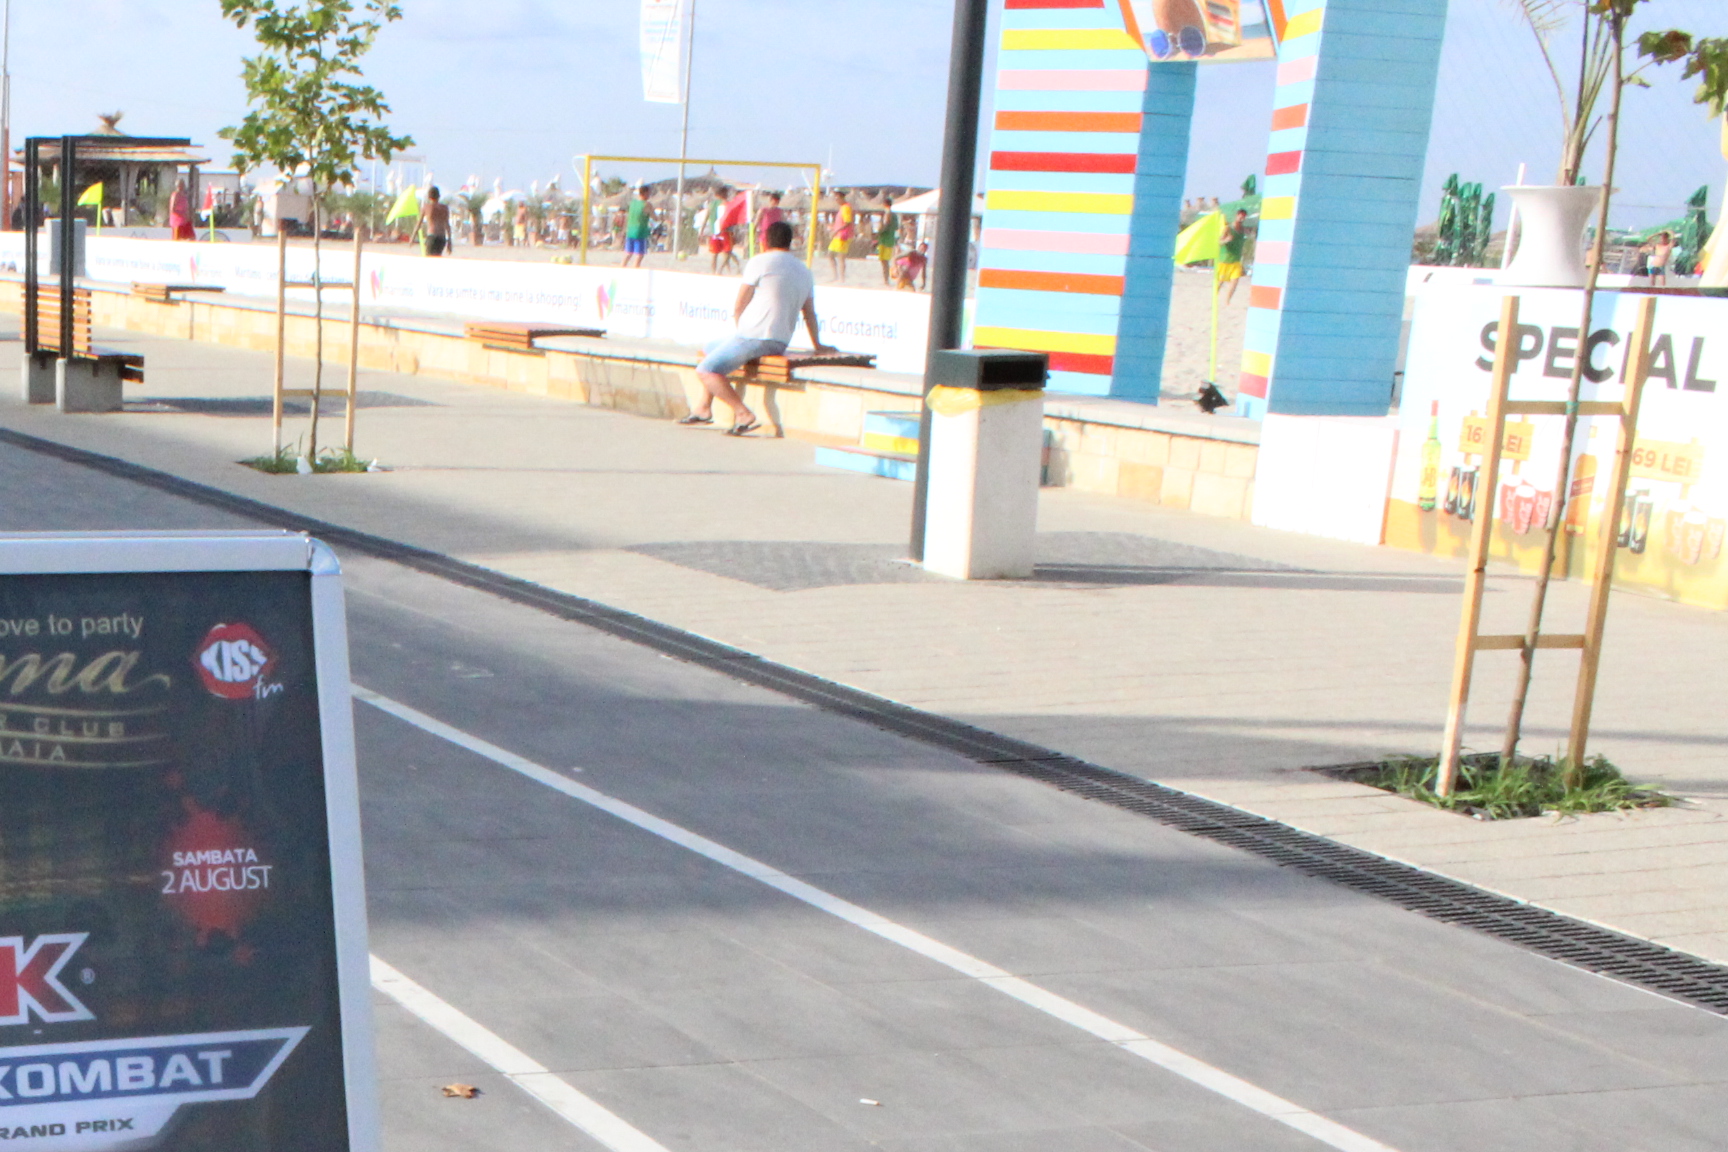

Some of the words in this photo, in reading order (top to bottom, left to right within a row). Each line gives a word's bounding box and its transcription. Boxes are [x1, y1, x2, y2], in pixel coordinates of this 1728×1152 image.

[678, 301, 728, 322] Maritimo
[1475, 321, 1717, 394] SPECIAL
[1660, 453, 1693, 477] LEI
[48, 615, 73, 636] to
[81, 613, 143, 639] party
[33, 717, 127, 738] CLUB
[172, 847, 258, 868] SAMBATA
[161, 870, 177, 894] 2
[178, 864, 273, 894] AUGUST
[75, 1116, 135, 1136] PRIX
